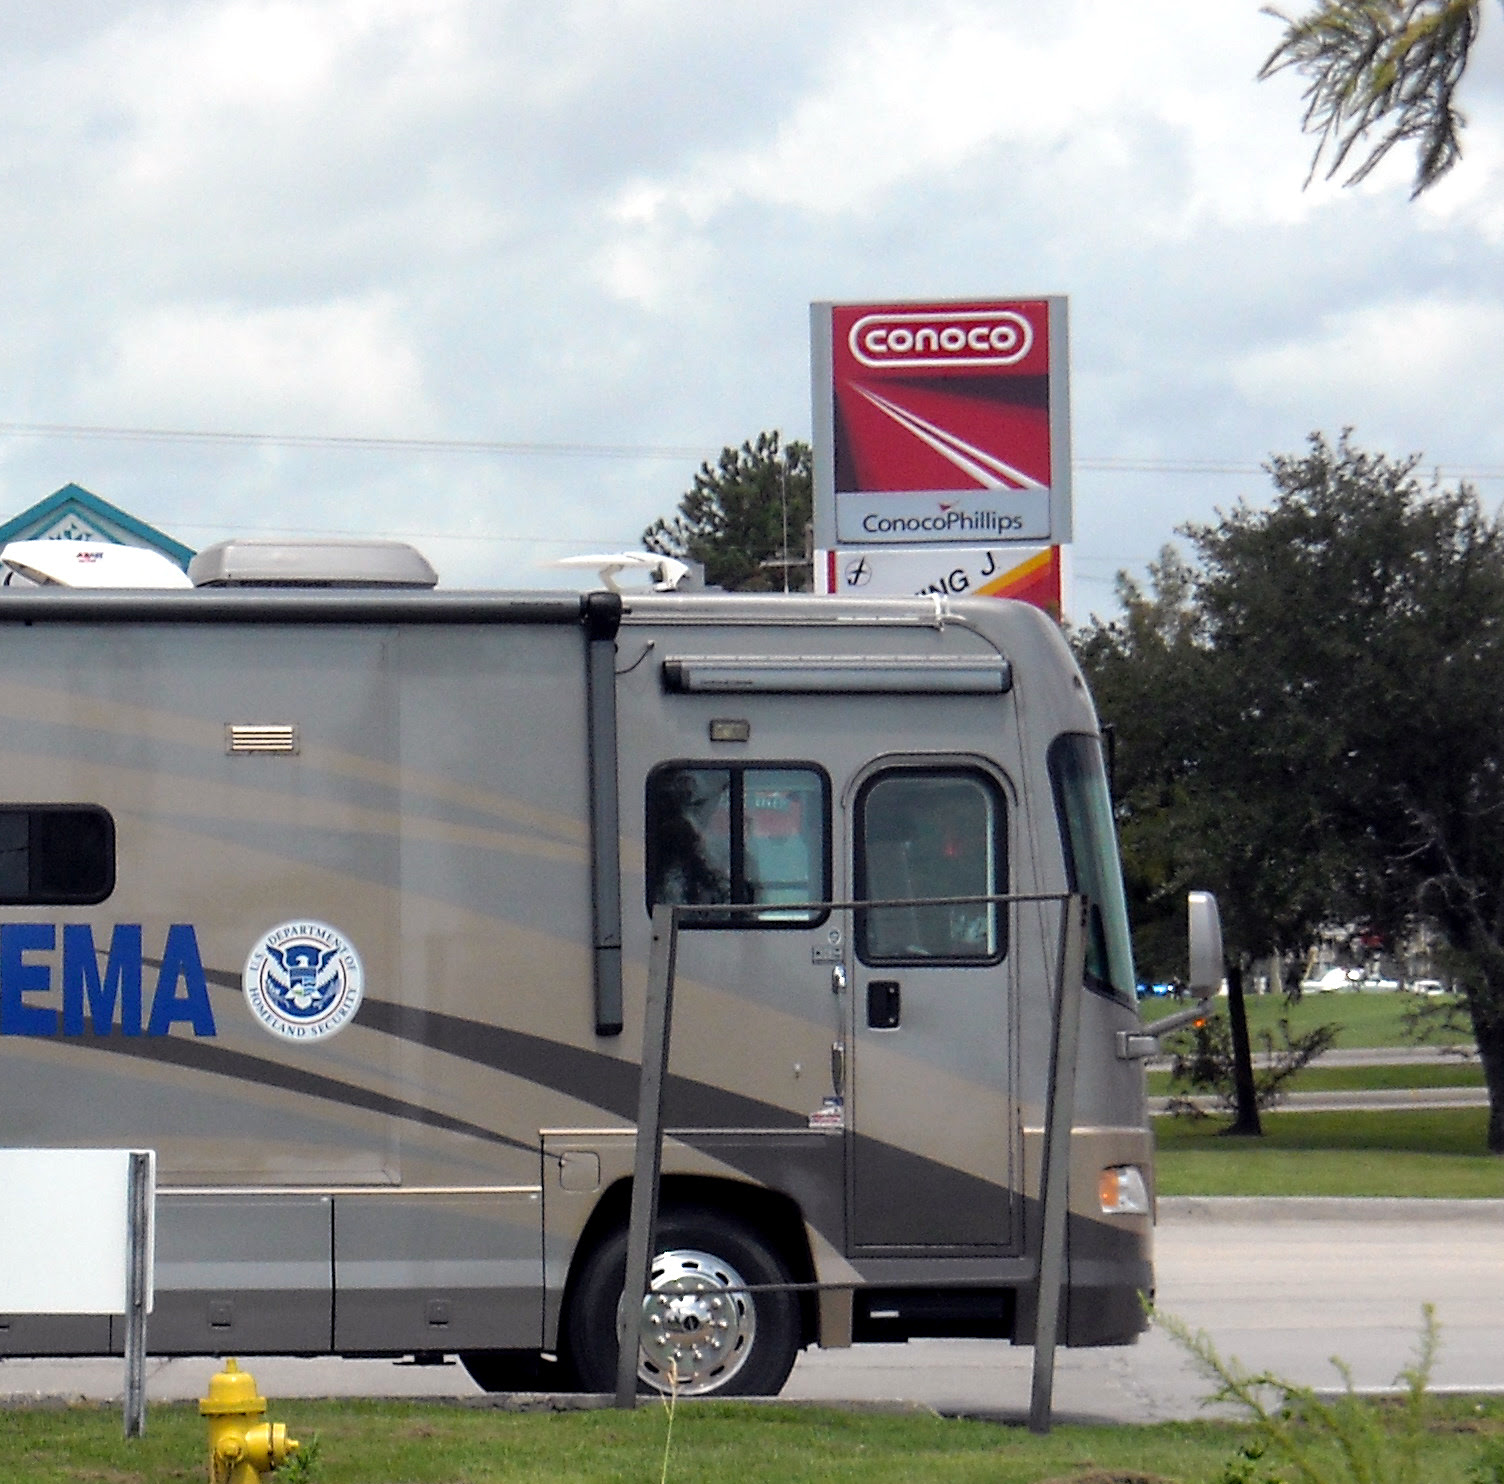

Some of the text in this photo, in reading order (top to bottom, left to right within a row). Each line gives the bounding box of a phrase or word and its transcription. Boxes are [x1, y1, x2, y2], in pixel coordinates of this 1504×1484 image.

[865, 327, 1017, 353] conoco
[862, 510, 1024, 534] ConocoPhillips
[981, 551, 995, 576] J
[268, 925, 347, 954] DEPARTMENT
[250, 987, 356, 1036] HOMELAND SECURITY
